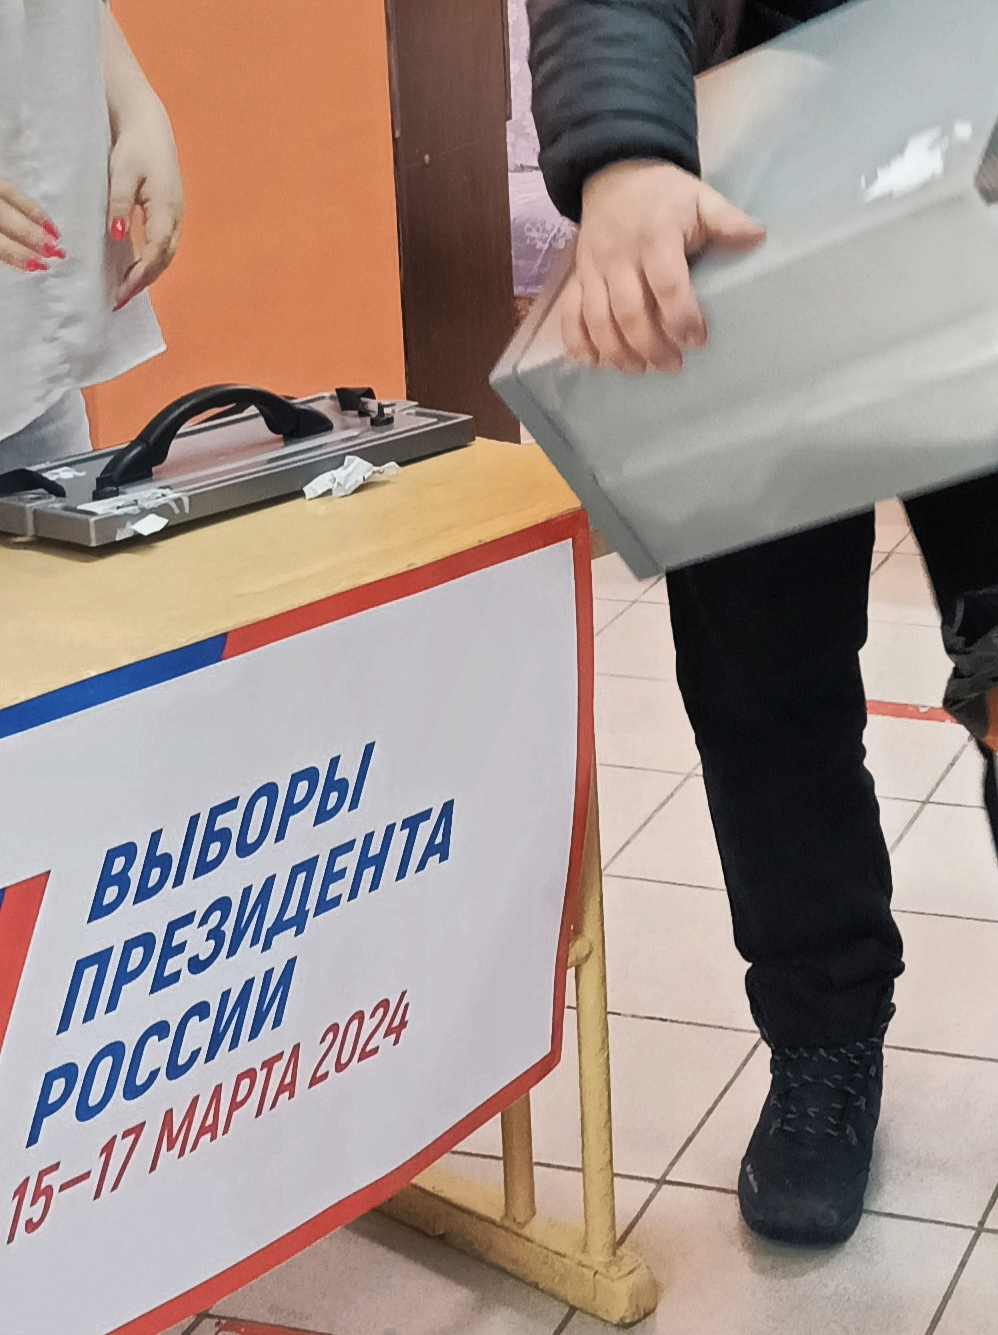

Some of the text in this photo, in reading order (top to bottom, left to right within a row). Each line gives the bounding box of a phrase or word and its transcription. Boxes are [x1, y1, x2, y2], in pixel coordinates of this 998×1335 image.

[56, 798, 455, 1036] ПРЕЗИДЕНТА
[87, 742, 376, 925] ВЫБОРЫ
[26, 956, 299, 1149] РОССИИ
[148, 1042, 301, 1173] МАРТА
[307, 988, 411, 1092] 2024
